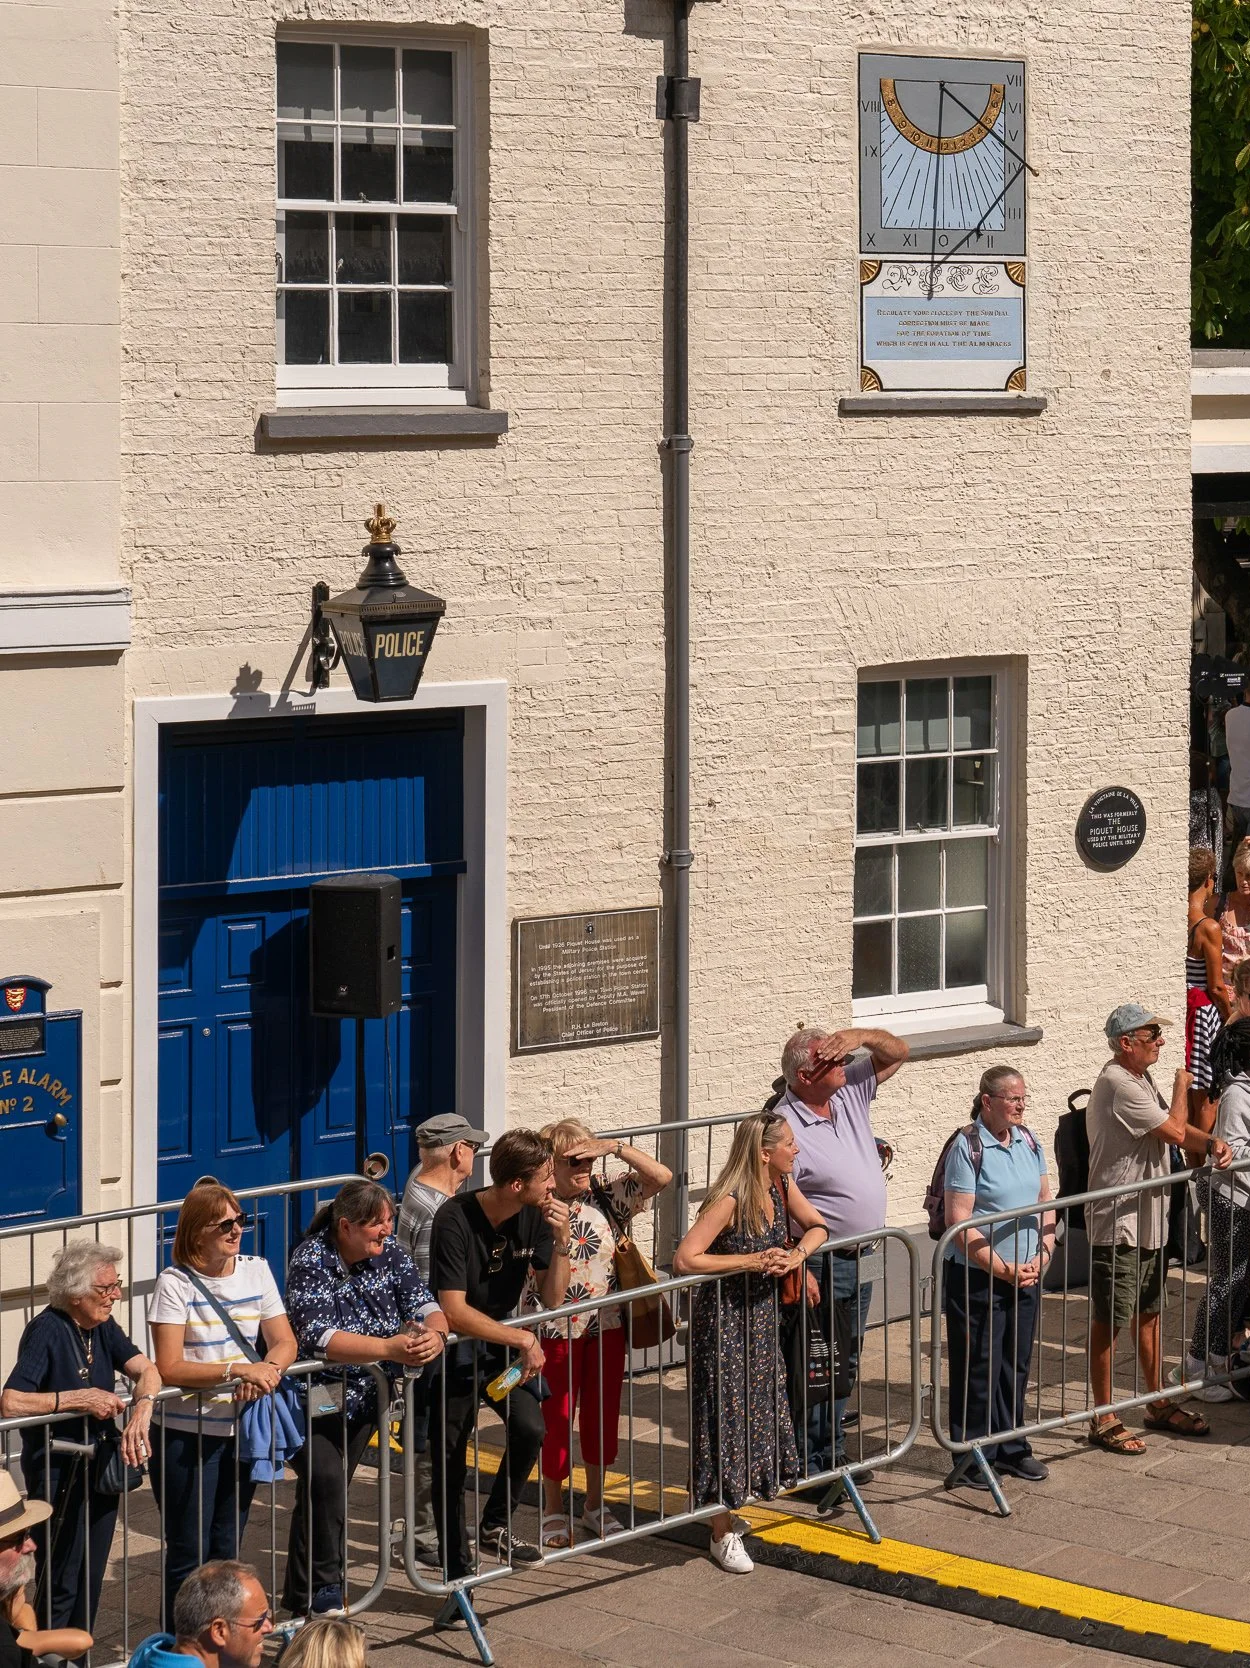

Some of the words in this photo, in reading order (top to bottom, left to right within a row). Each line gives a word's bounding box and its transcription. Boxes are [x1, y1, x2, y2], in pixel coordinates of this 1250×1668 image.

[1007, 75, 1022, 86] VII
[862, 101, 880, 112] VIII
[1008, 102, 1022, 114] VI
[910, 132, 920, 142] 10
[940, 142, 949, 150] 12
[961, 139, 968, 148] 2
[970, 133, 976, 142] 3
[1008, 130, 1018, 142] V
[865, 145, 878, 158] IX
[1008, 208, 1021, 220] III
[866, 232, 876, 246] X
[902, 234, 917, 247] XI
[987, 235, 994, 248] II
[375, 631, 425, 659] POLICE
[1090, 826, 1114, 835] PIQUET
[1117, 824, 1138, 833] HOUSE
[608, 996, 635, 1004] Committee
[17, 1068, 72, 1106] ALARM
[23, 1096, 33, 1112] 2
